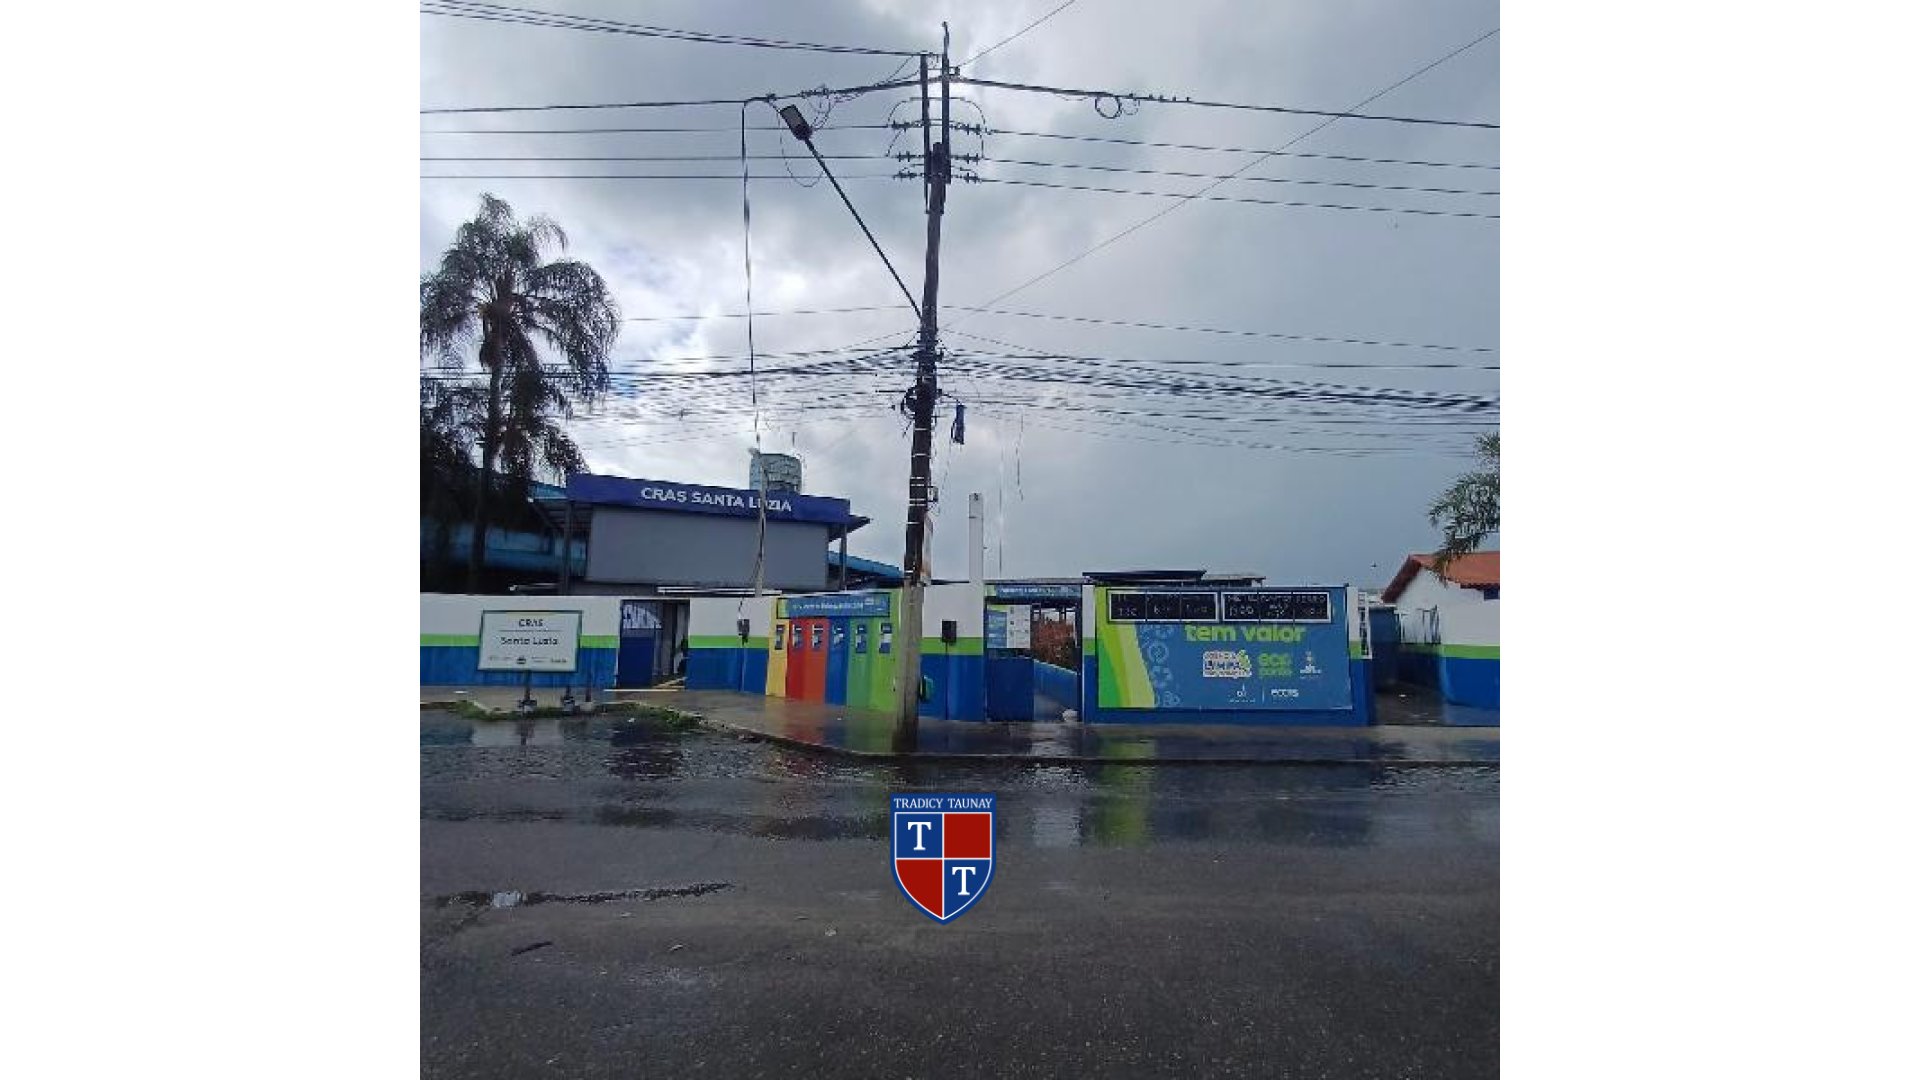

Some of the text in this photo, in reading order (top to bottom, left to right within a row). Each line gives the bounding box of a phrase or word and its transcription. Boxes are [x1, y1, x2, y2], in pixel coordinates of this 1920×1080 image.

[640, 487, 687, 503] CRAS
[691, 491, 745, 508] SANTA
[1184, 624, 1307, 642] tem valor
